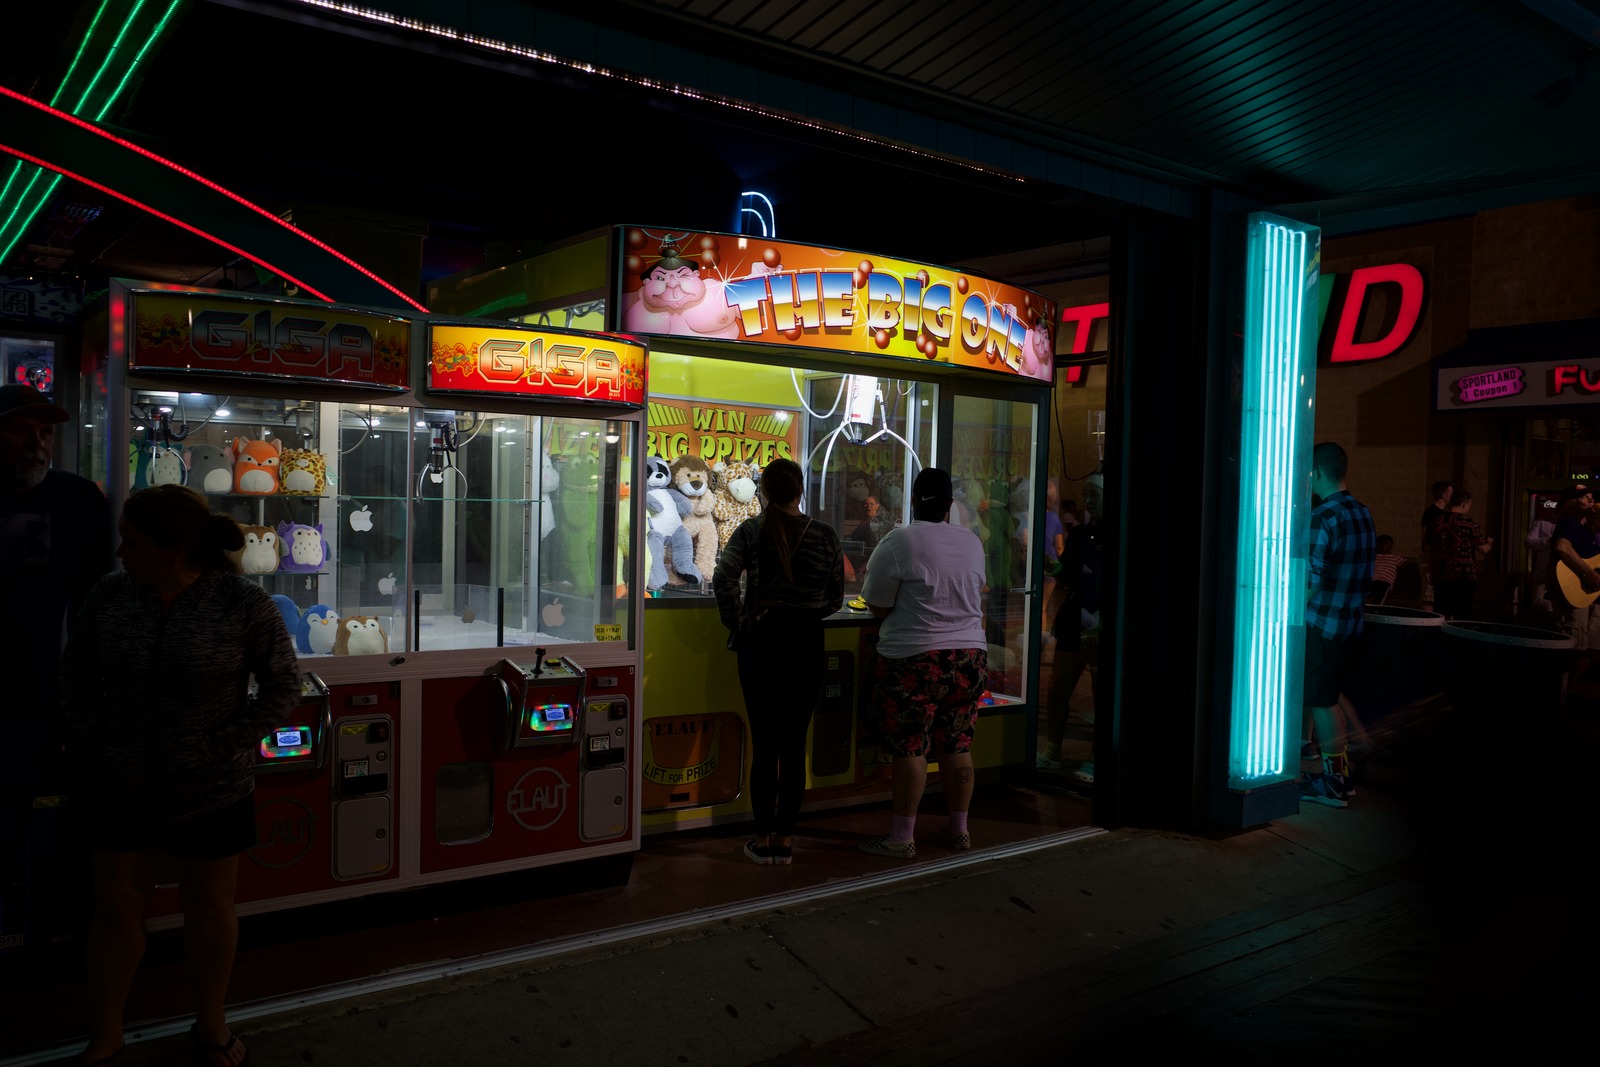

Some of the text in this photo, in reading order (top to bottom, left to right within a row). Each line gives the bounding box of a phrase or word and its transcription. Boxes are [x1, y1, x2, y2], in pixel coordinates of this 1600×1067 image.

[724, 267, 1029, 373] THE BIG ONE
[191, 310, 375, 375] GIGA
[478, 337, 621, 396] GIGA
[1462, 369, 1516, 389] SPORTLAND
[1463, 381, 1518, 400] 1 Coupon 1
[691, 405, 748, 433] WIN
[647, 430, 690, 462] BIG
[655, 719, 713, 736] ELAUT
[644, 757, 717, 783] LIFT FOR PRIZE
[505, 782, 572, 815] ELAUT
[254, 815, 321, 849] LAUT
